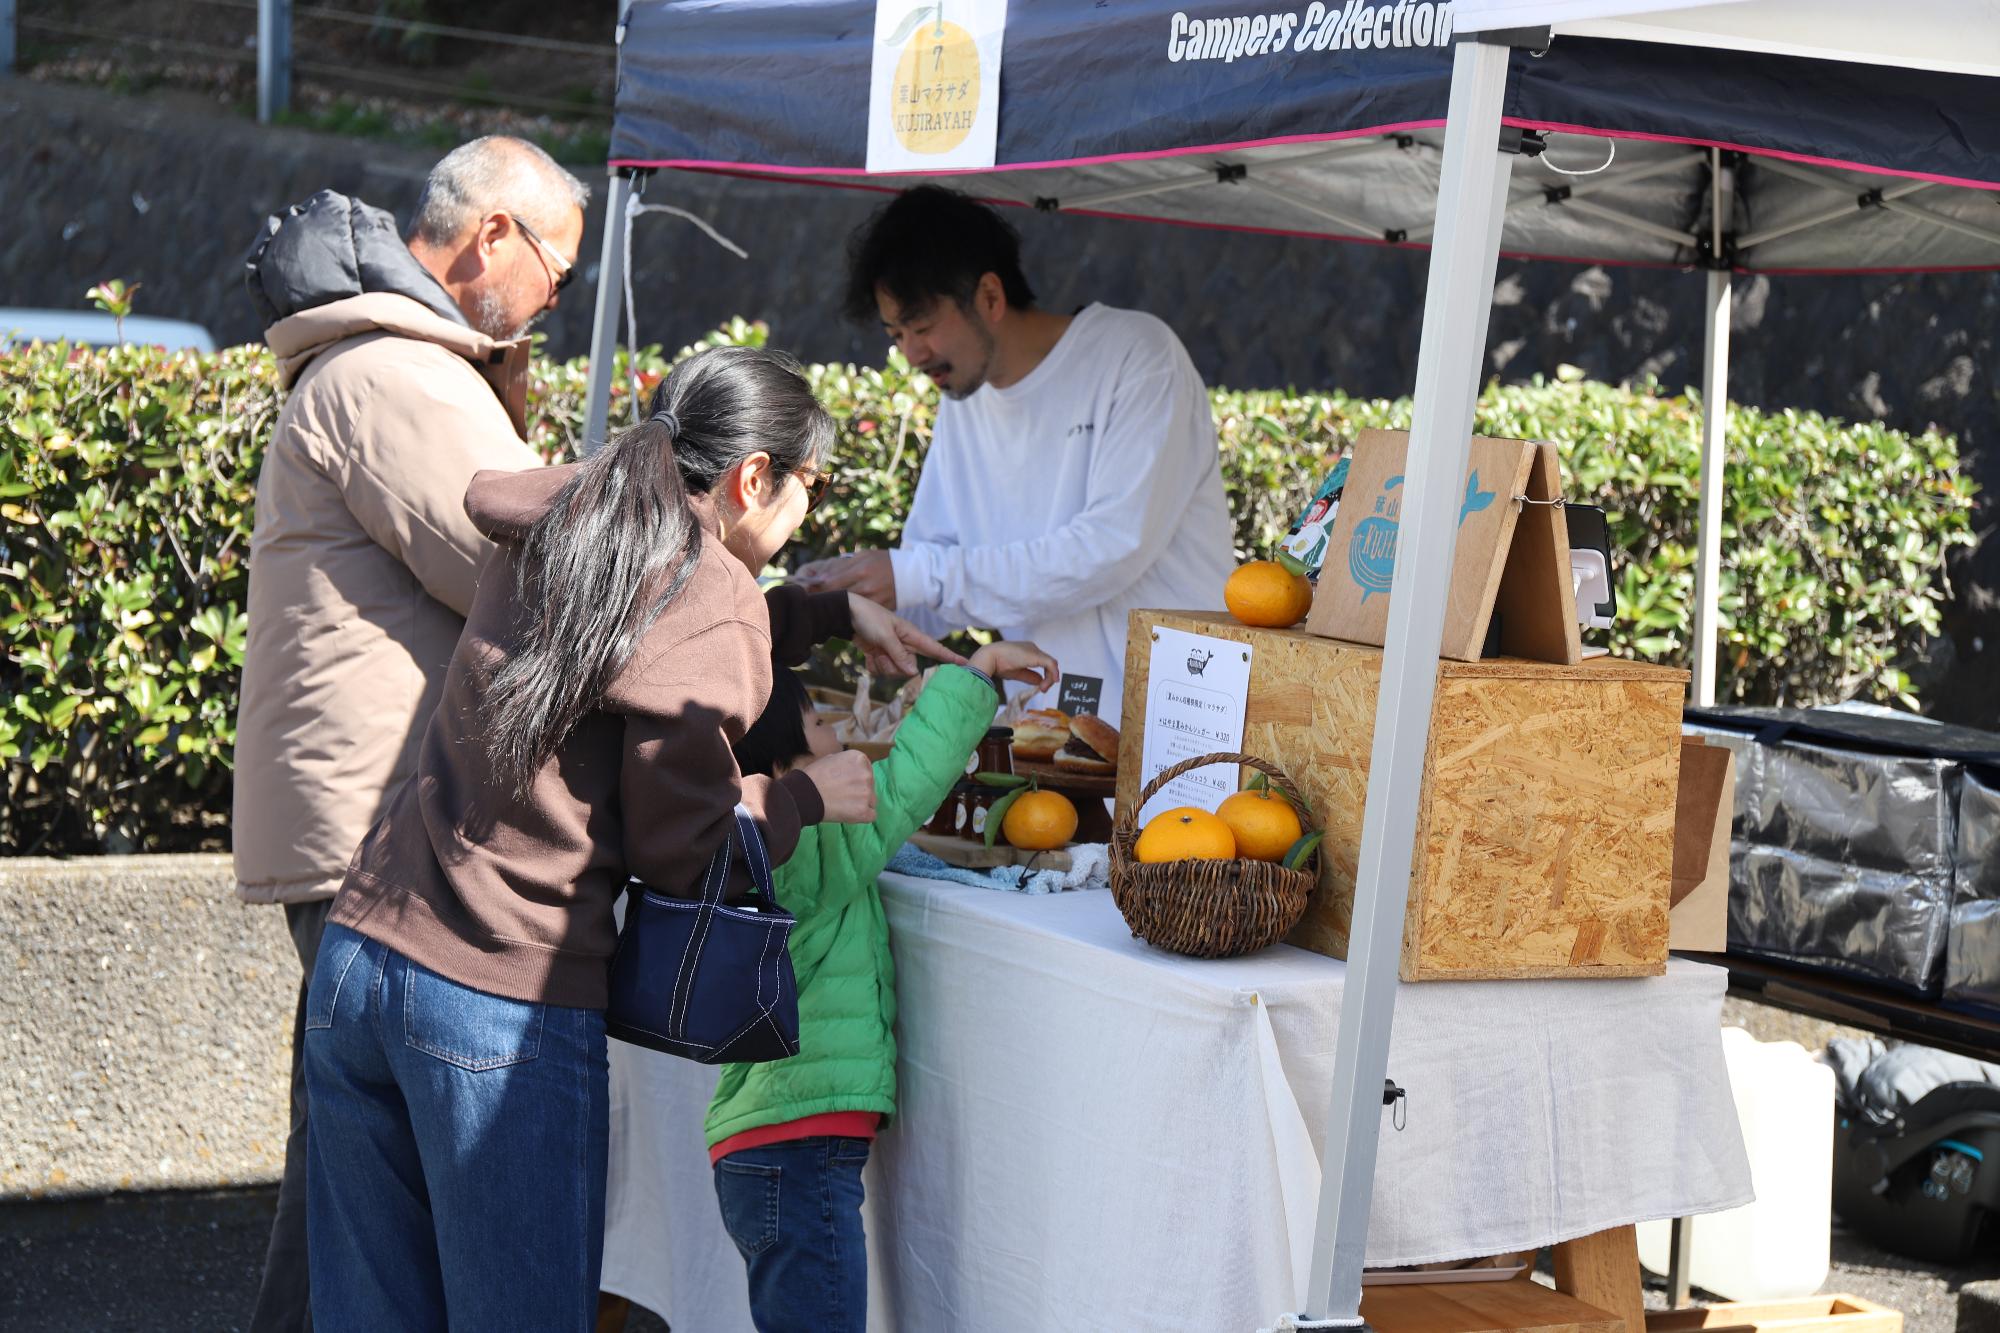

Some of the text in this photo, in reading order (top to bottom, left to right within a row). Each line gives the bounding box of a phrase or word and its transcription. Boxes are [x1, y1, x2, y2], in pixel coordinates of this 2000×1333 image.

[1168, 0, 1454, 62] Campers Collection
[933, 45, 944, 71] 7
[897, 111, 972, 132] KUJIRAYAH
